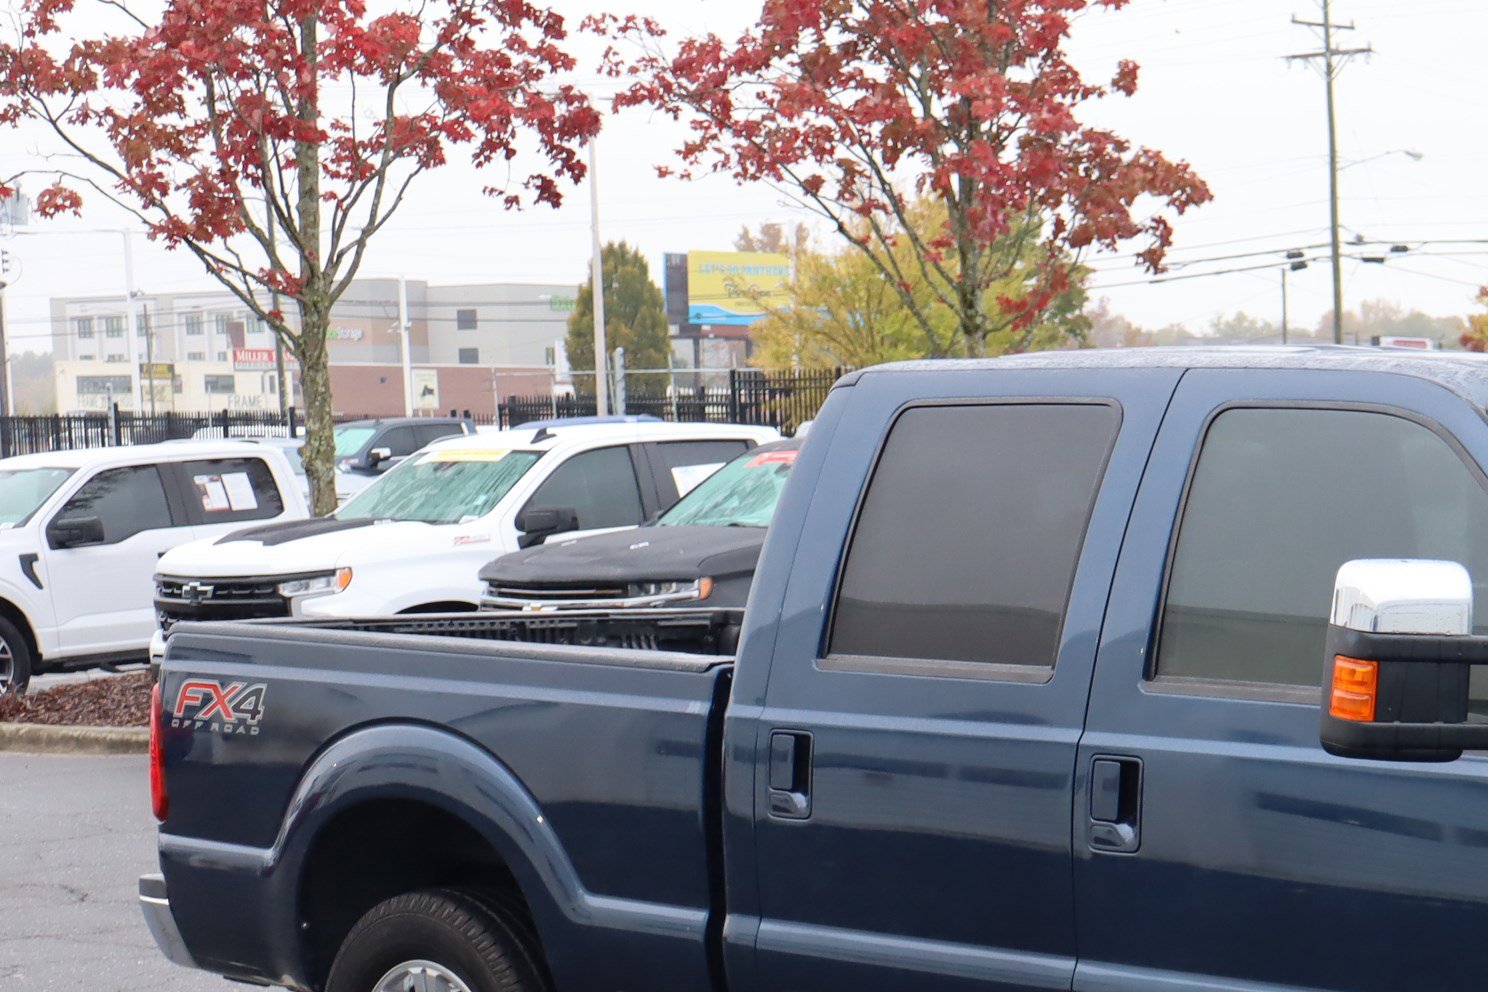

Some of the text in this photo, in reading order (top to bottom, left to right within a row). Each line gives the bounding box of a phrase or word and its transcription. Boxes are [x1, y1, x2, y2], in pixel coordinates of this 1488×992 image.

[235, 350, 270, 361] MILLER
[173, 678, 268, 726] FX4
[171, 719, 260, 736] OFF ROAD
